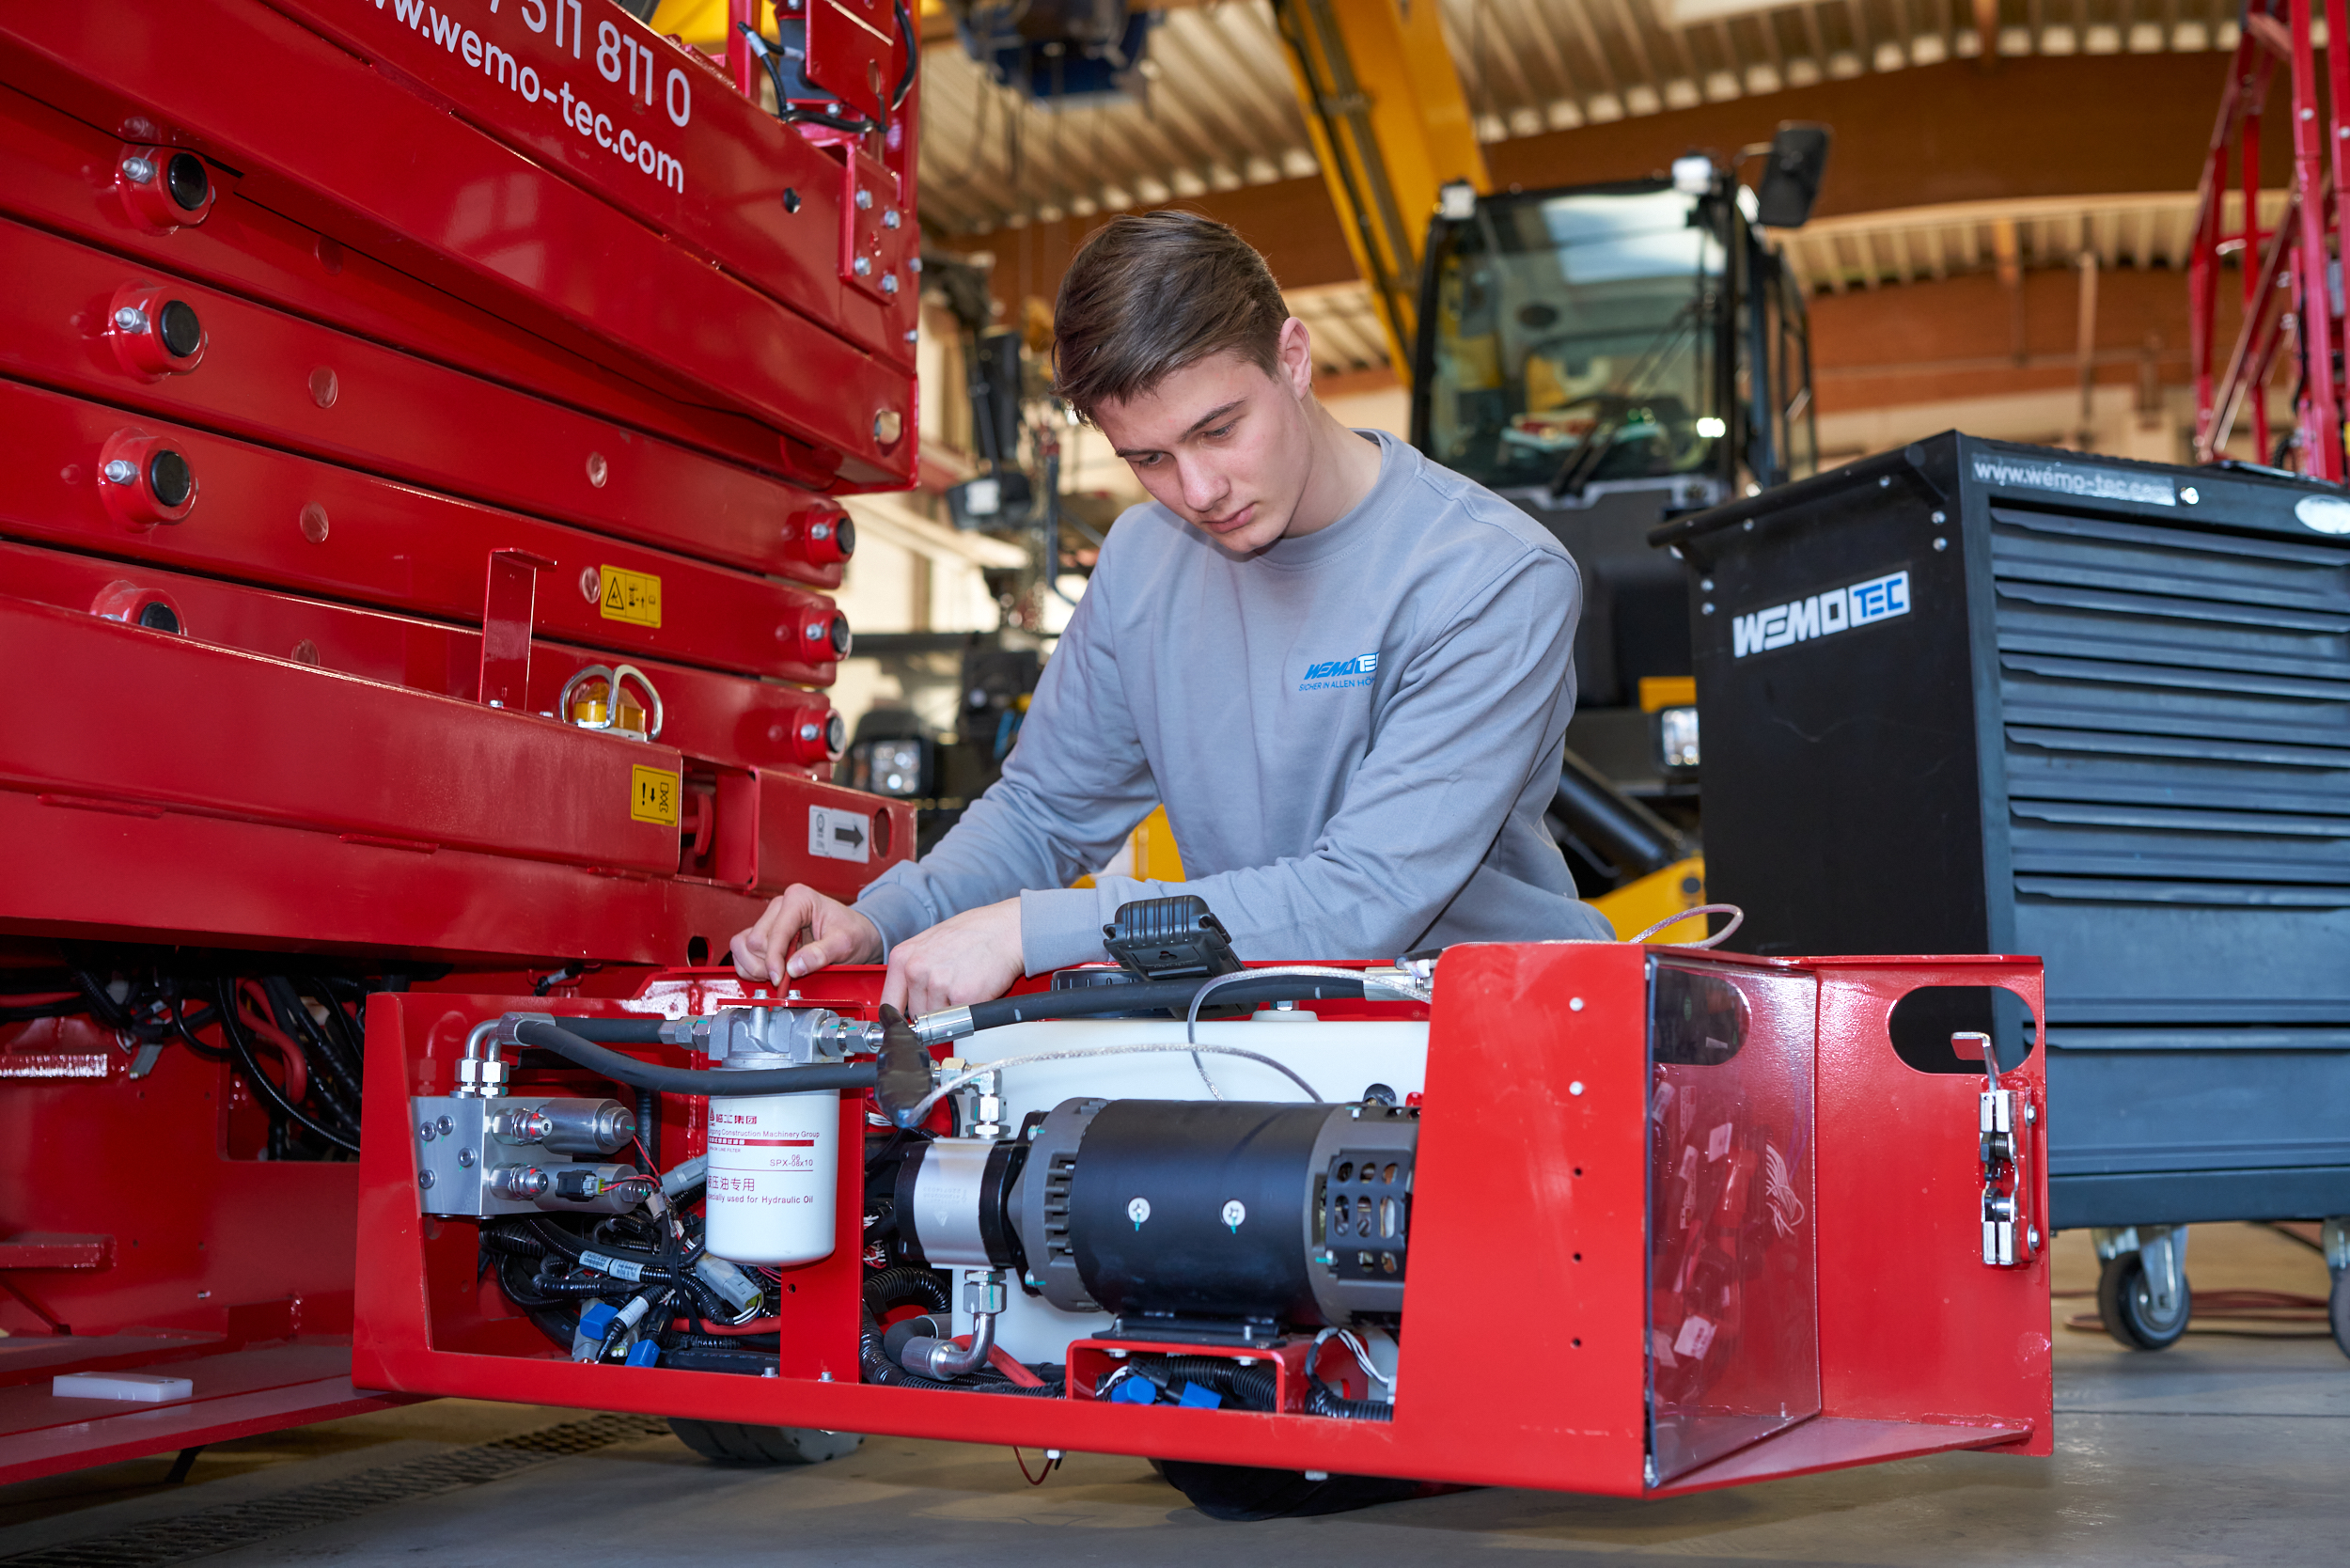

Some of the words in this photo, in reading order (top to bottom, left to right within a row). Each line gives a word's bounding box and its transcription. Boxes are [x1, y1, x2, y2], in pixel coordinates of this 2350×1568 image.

[596, 20, 654, 106] 811
[666, 68, 691, 127] 0
[1303, 651, 1379, 681] WEMOTE
[1330, 680, 1355, 688] ALLEN
[722, 1129, 761, 1137] Construction
[727, 1195, 744, 1203] used
[746, 1195, 759, 1203] for
[761, 1196, 801, 1206] Hydraulic
[803, 1195, 814, 1203] Oil
